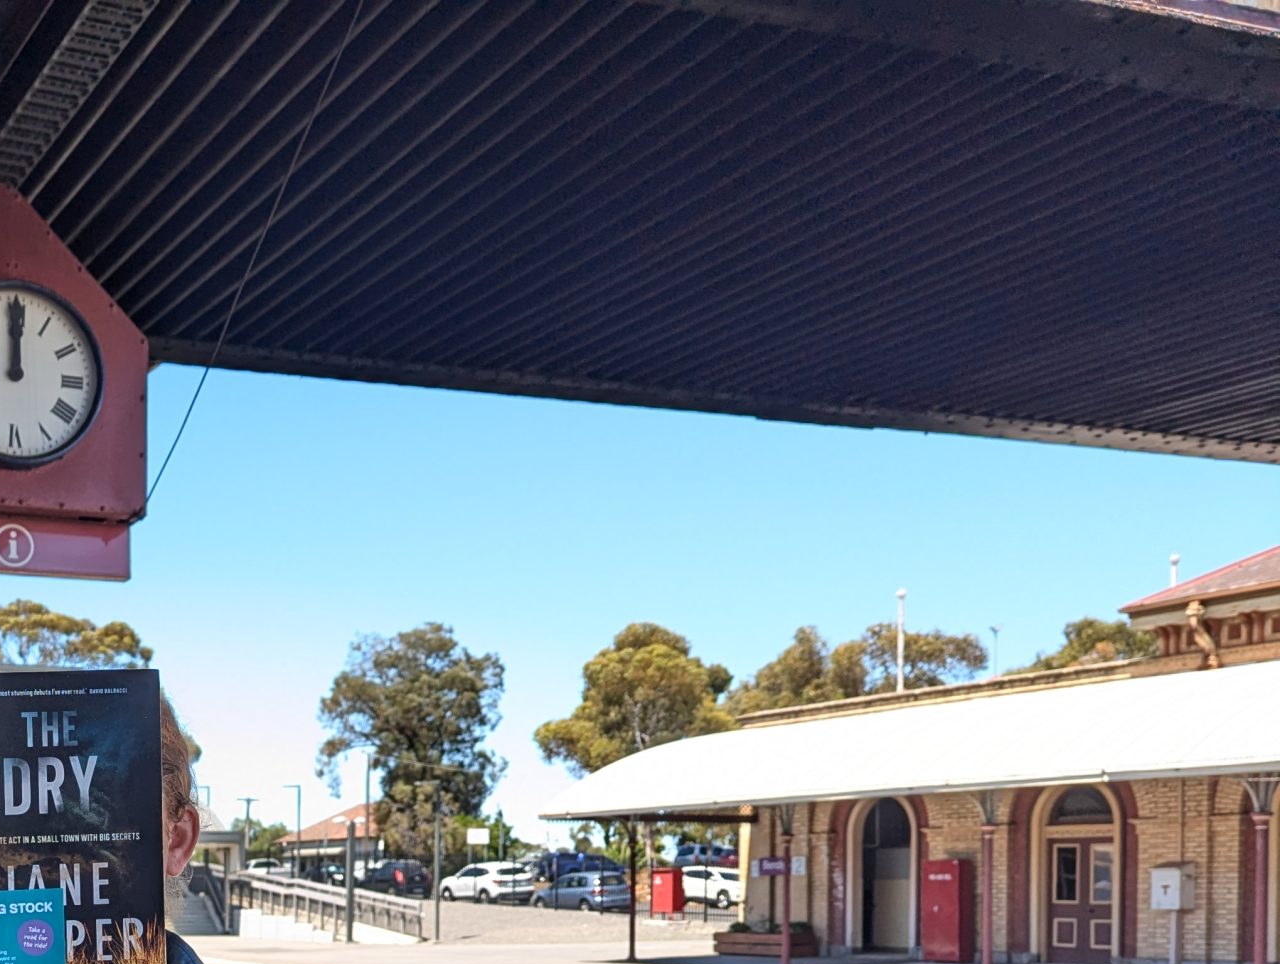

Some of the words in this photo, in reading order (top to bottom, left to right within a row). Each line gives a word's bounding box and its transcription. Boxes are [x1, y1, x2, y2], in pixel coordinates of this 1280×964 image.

[21, 711, 79, 748] THE
[3, 755, 98, 816] DRY
[9, 836, 21, 844] ACT
[23, 836, 30, 844] IN
[31, 835, 36, 843] A
[37, 835, 59, 844] SMALL
[60, 834, 80, 843] TOWN
[81, 833, 98, 842] WITH
[99, 833, 110, 841] BIG
[111, 832, 140, 841] SECRETS
[9, 901, 53, 914] STOCK
[66, 917, 145, 961] PER
